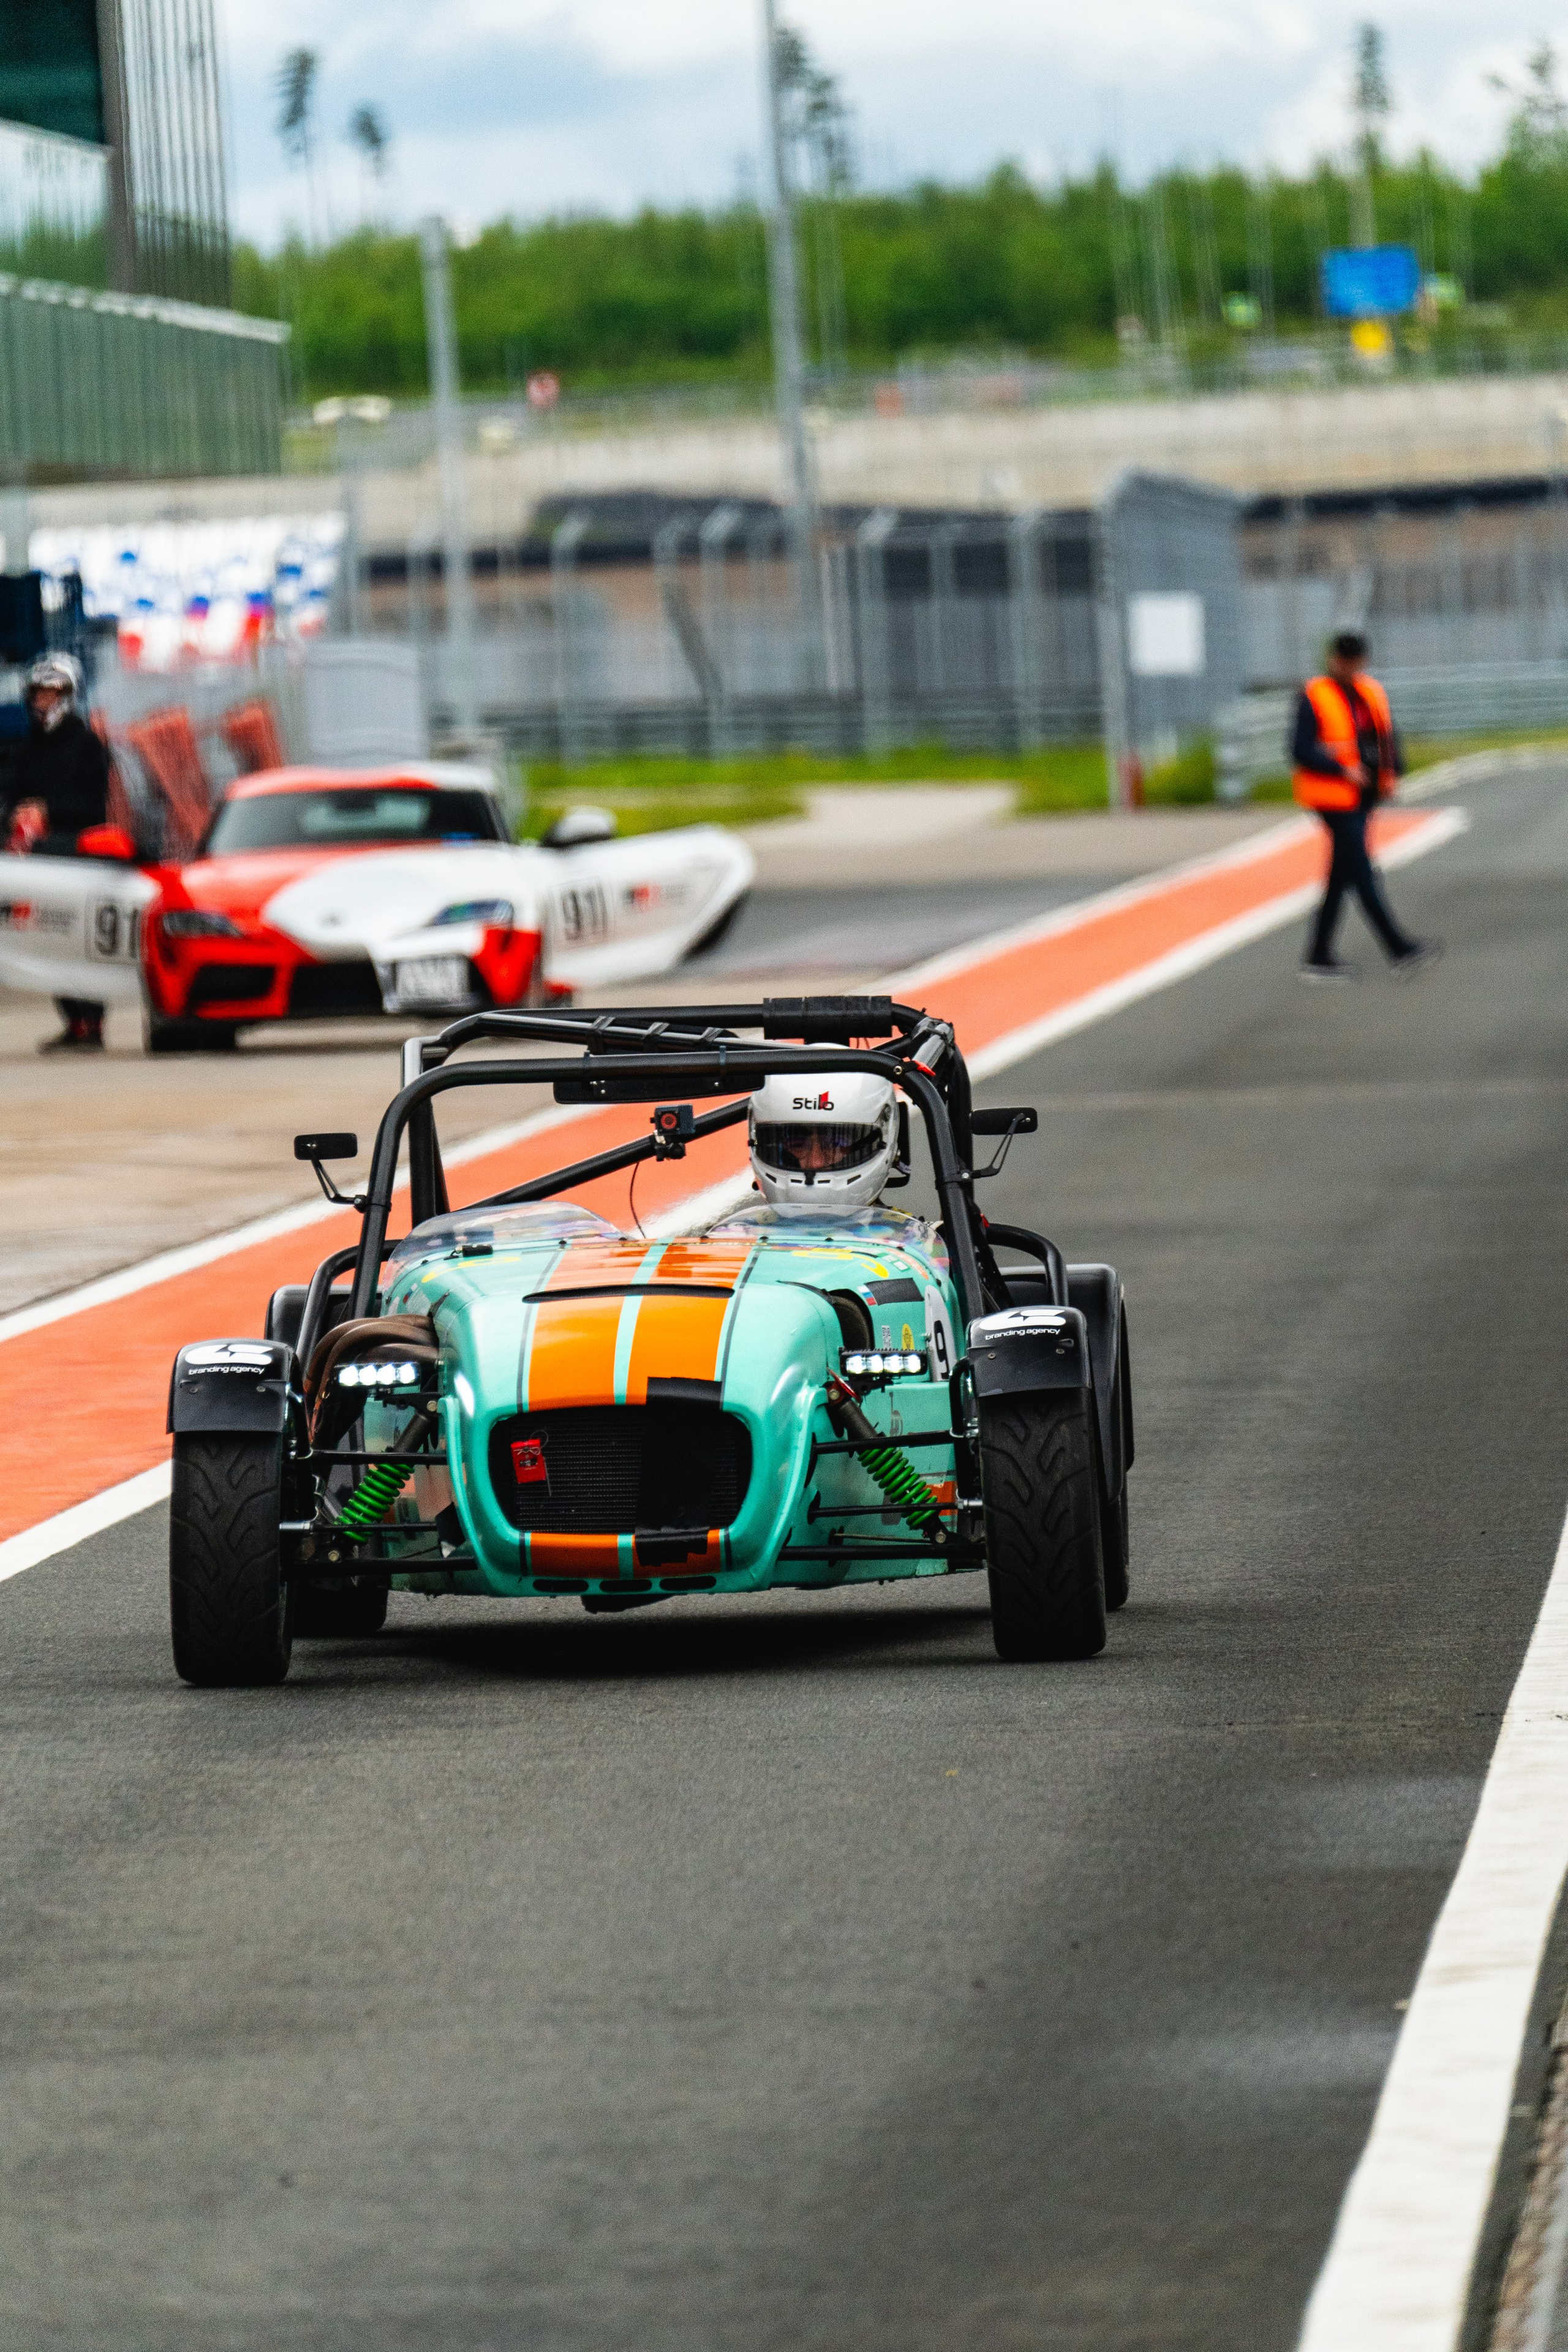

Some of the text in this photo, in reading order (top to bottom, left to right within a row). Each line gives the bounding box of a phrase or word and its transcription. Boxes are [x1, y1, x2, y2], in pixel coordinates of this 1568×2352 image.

[793, 1091, 834, 1111] Stilo
[986, 1329, 1025, 1340] branding
[188, 1366, 229, 1376] branding
